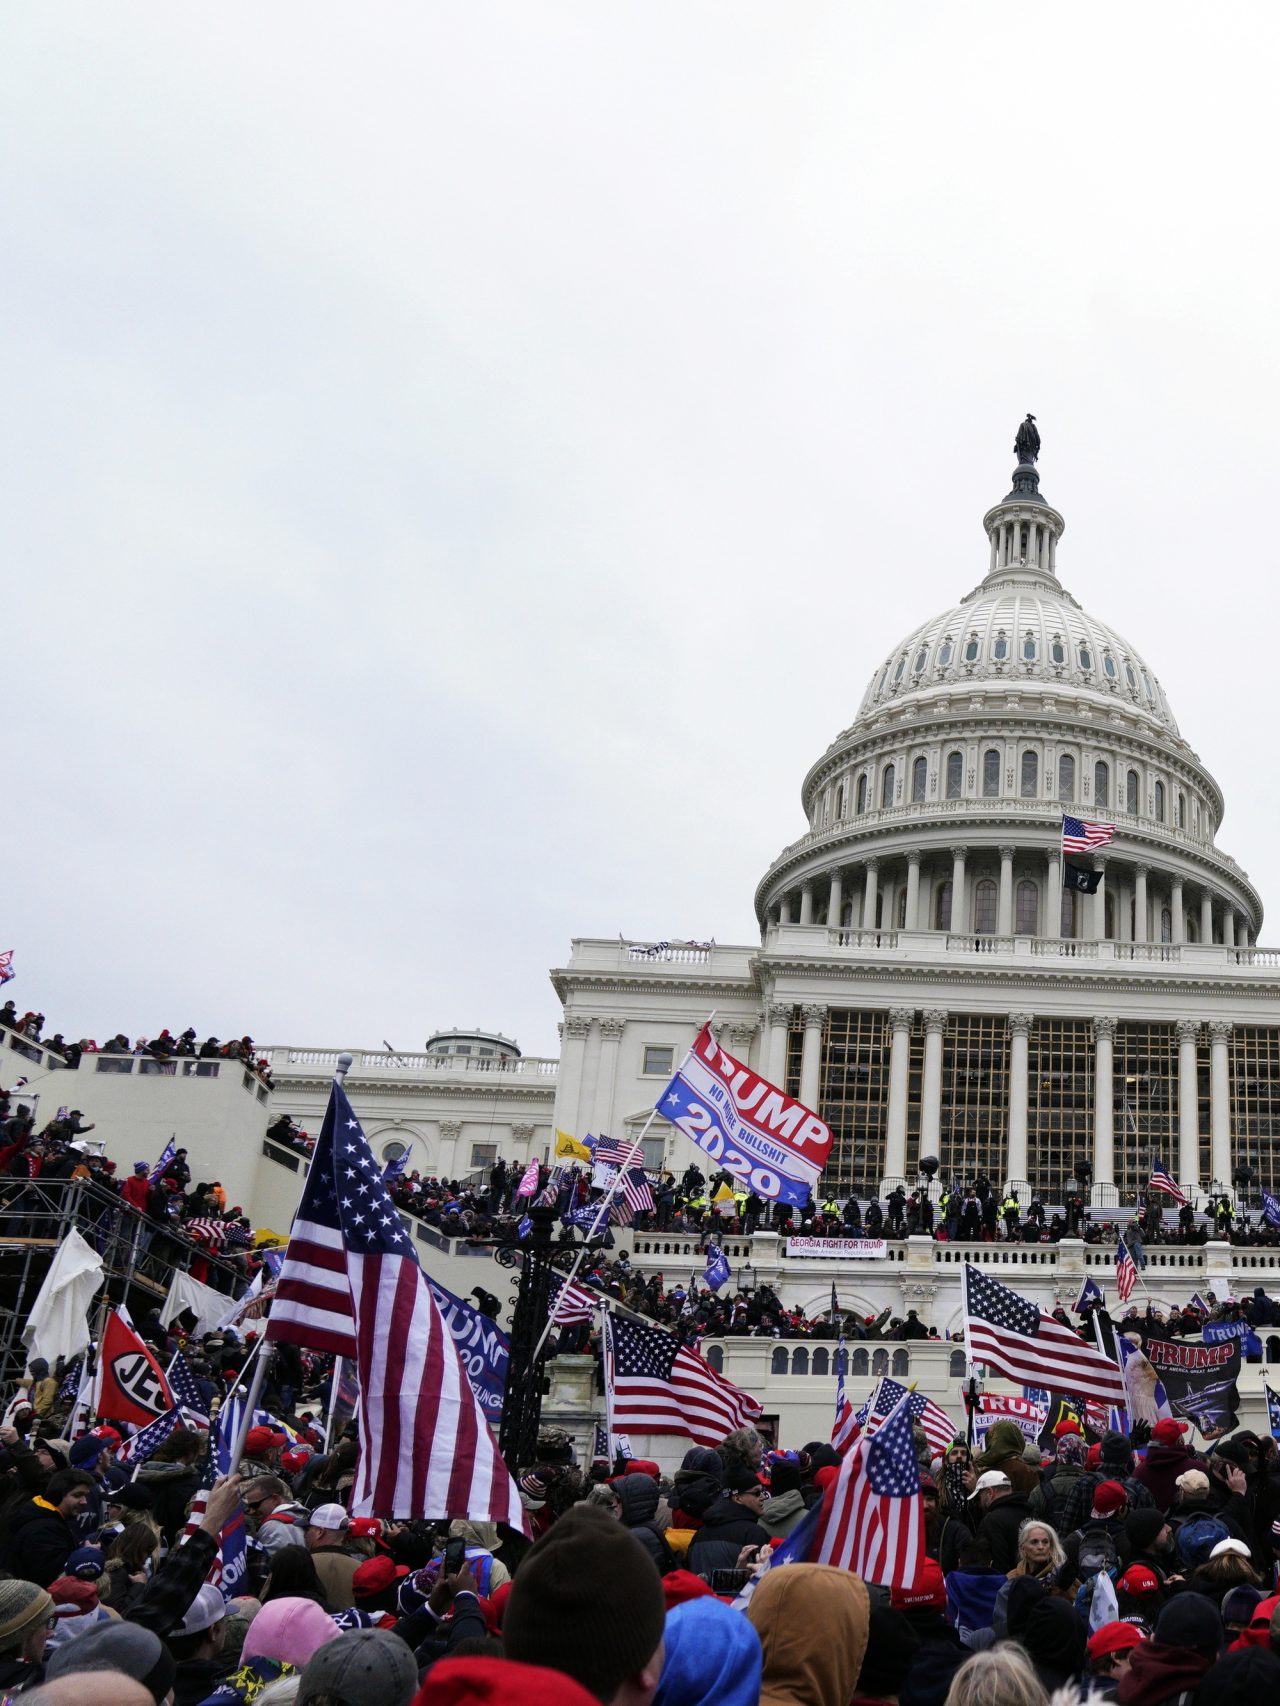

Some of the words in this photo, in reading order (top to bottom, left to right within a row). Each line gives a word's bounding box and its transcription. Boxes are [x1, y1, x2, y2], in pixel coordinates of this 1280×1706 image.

[675, 1102, 781, 1197] 2020
[708, 1083, 725, 1102] NO
[722, 1099, 737, 1131] MORE
[738, 1129, 789, 1165] BULLSHIT
[790, 1238, 821, 1248] GEORGIA
[822, 1239, 842, 1249] FIGHT
[843, 1240, 858, 1249] FOR
[860, 1240, 883, 1249] TRUMP
[1146, 1337, 1235, 1369] TRUMP
